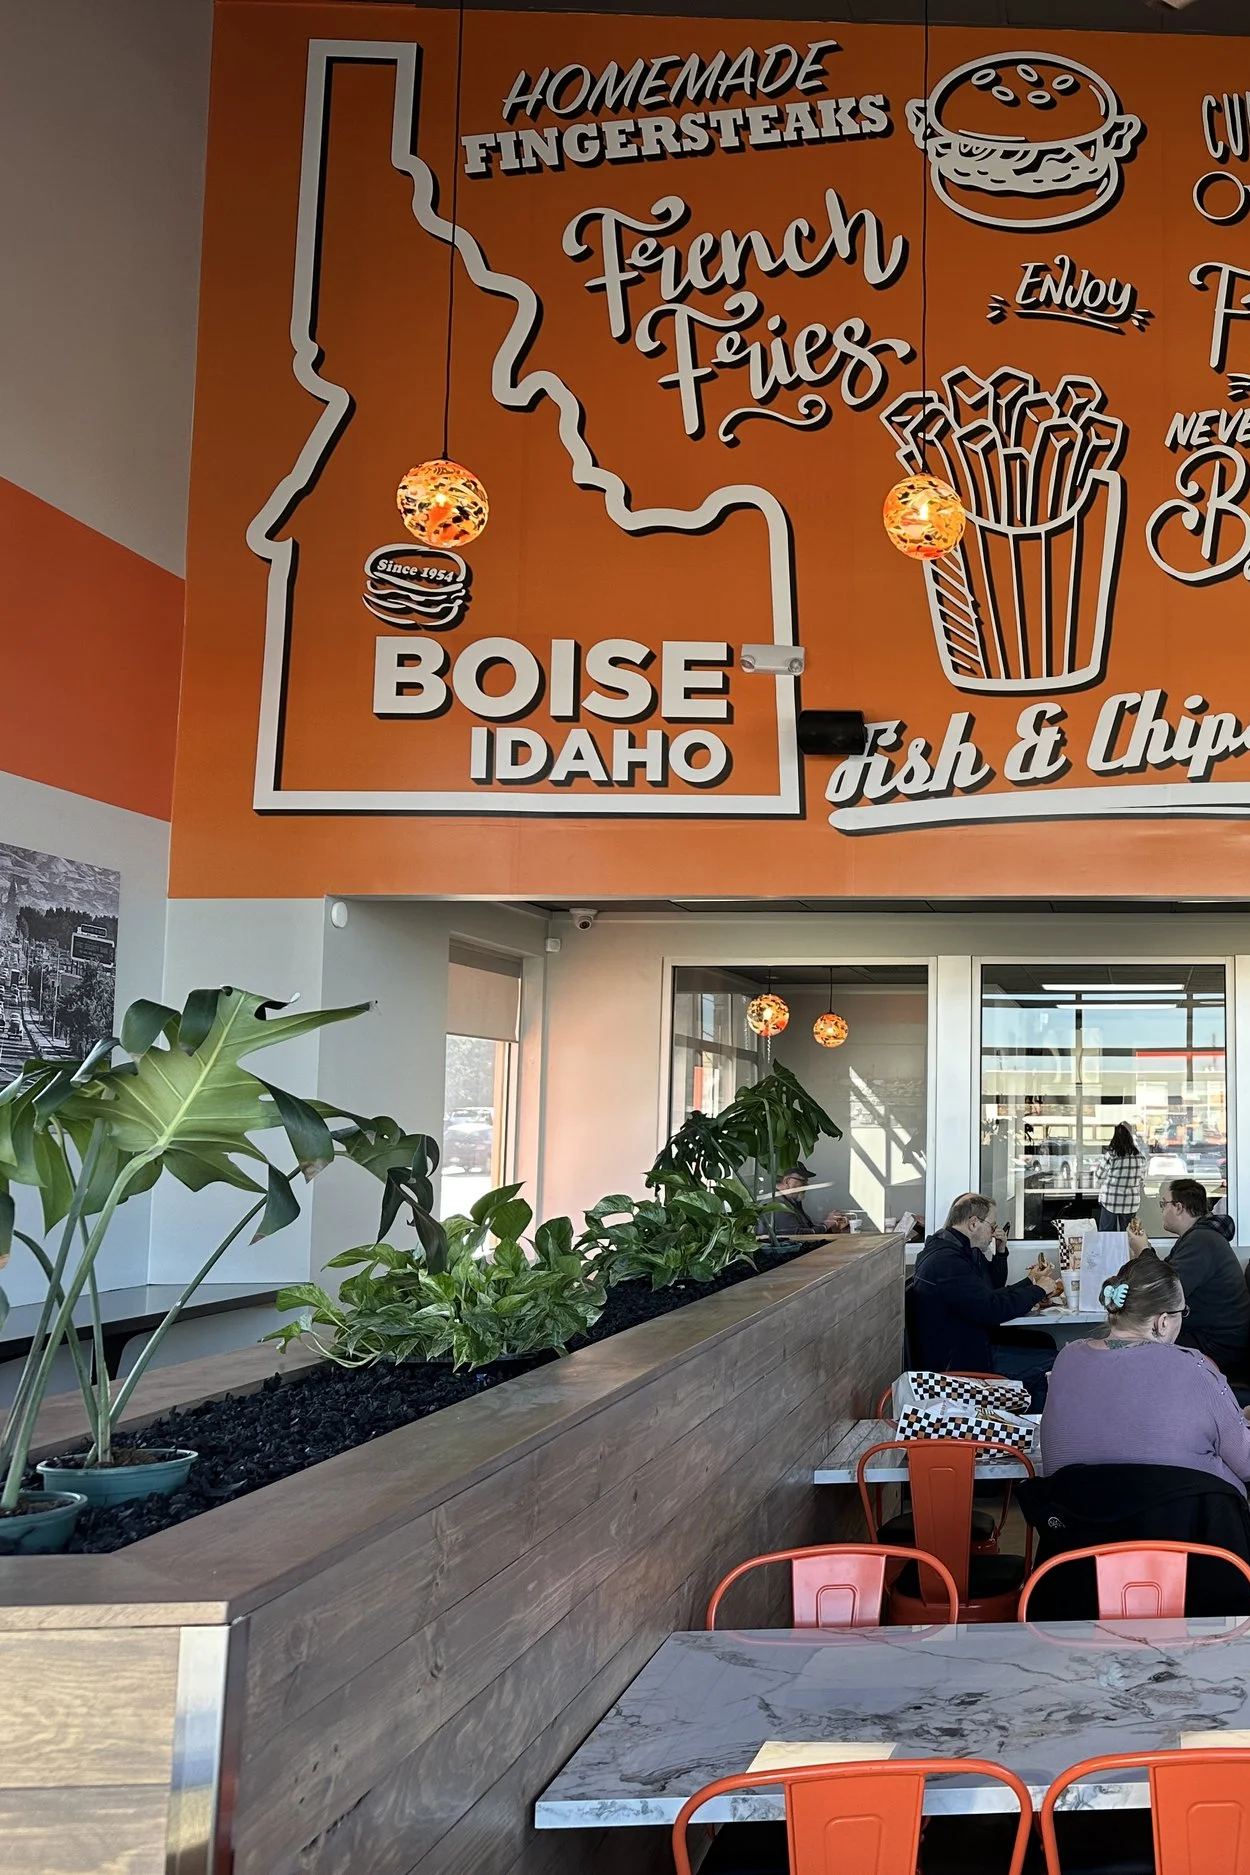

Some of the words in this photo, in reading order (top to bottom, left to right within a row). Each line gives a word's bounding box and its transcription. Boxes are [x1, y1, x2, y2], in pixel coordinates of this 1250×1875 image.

[502, 39, 840, 120] HOMEMADE
[462, 94, 888, 175] FINGERSTEAKS
[561, 188, 902, 341] French
[636, 291, 911, 436] Fries
[377, 559, 418, 576] Since
[420, 567, 454, 582] 1954
[373, 636, 728, 719] BOISE
[470, 727, 727, 783] IDAHO
[825, 711, 990, 802] Fish
[1003, 701, 1068, 782] &
